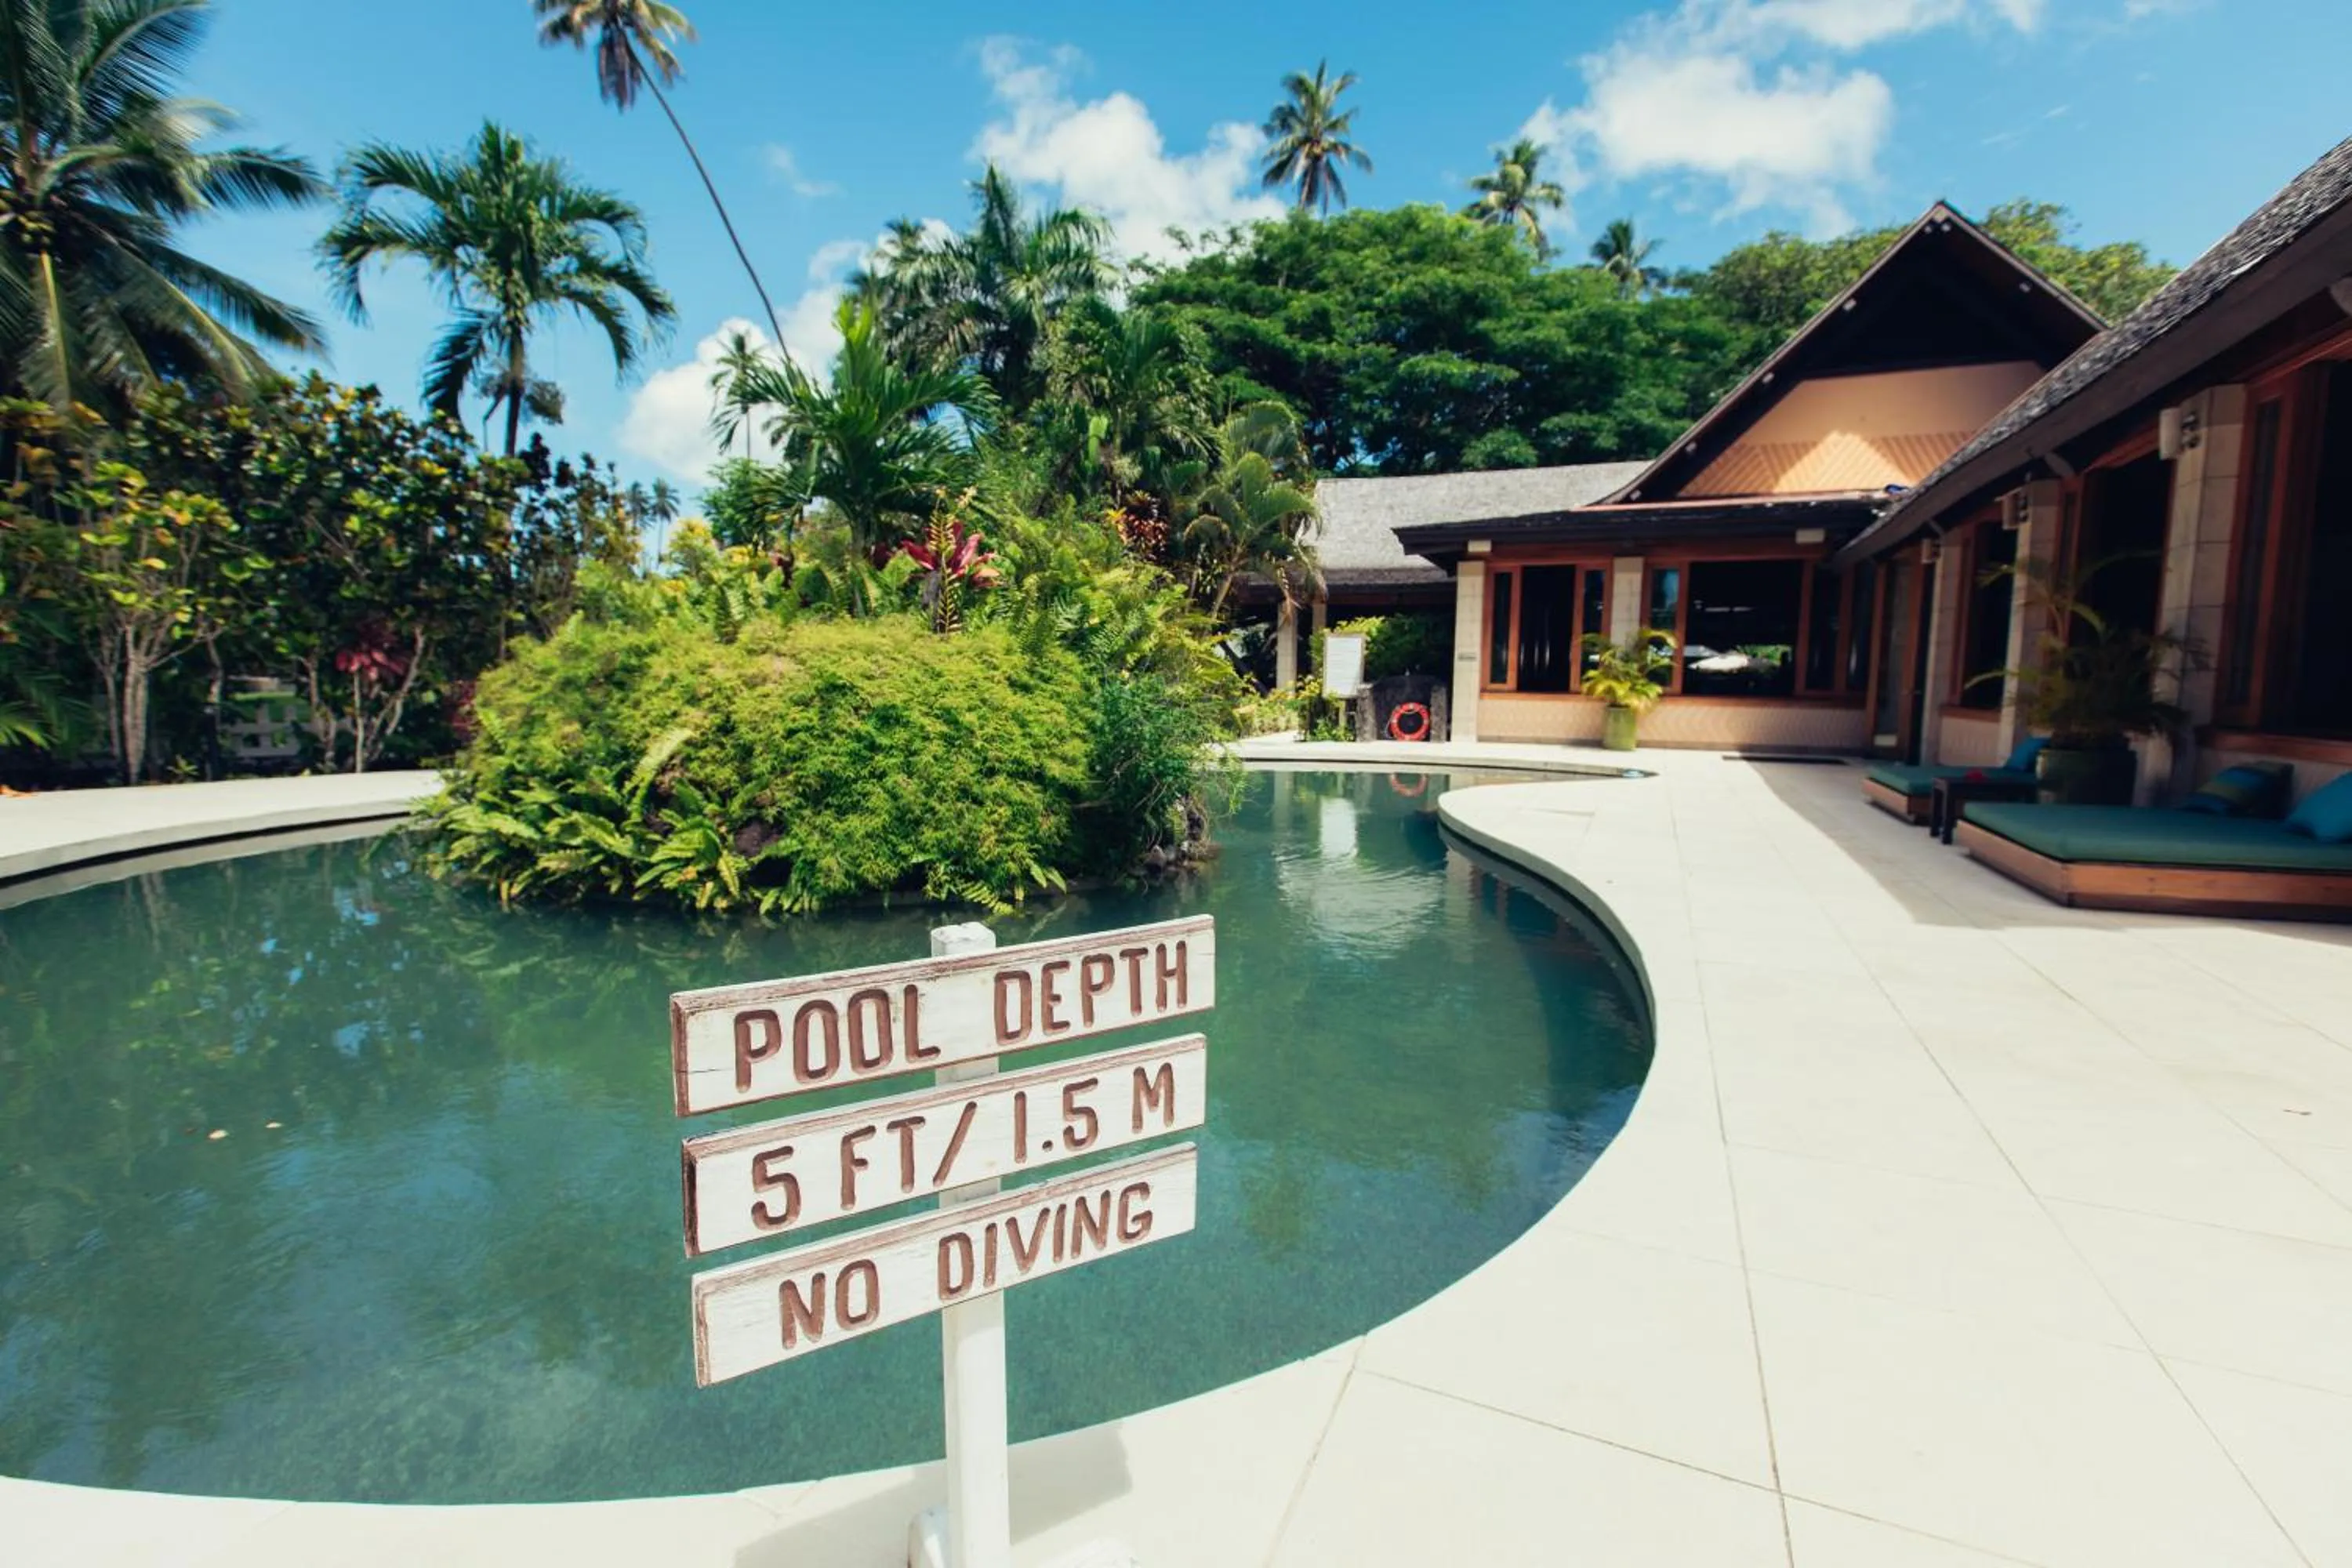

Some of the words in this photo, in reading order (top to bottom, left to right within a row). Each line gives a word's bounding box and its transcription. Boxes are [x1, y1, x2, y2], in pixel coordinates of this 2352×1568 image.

[734, 984, 941, 1092] POOL
[993, 940, 1189, 1047] DEPTH
[750, 1145, 801, 1231] 5
[1131, 1062, 1176, 1134] M
[778, 1258, 880, 1350] NO
[937, 1181, 1154, 1301] DIVING
